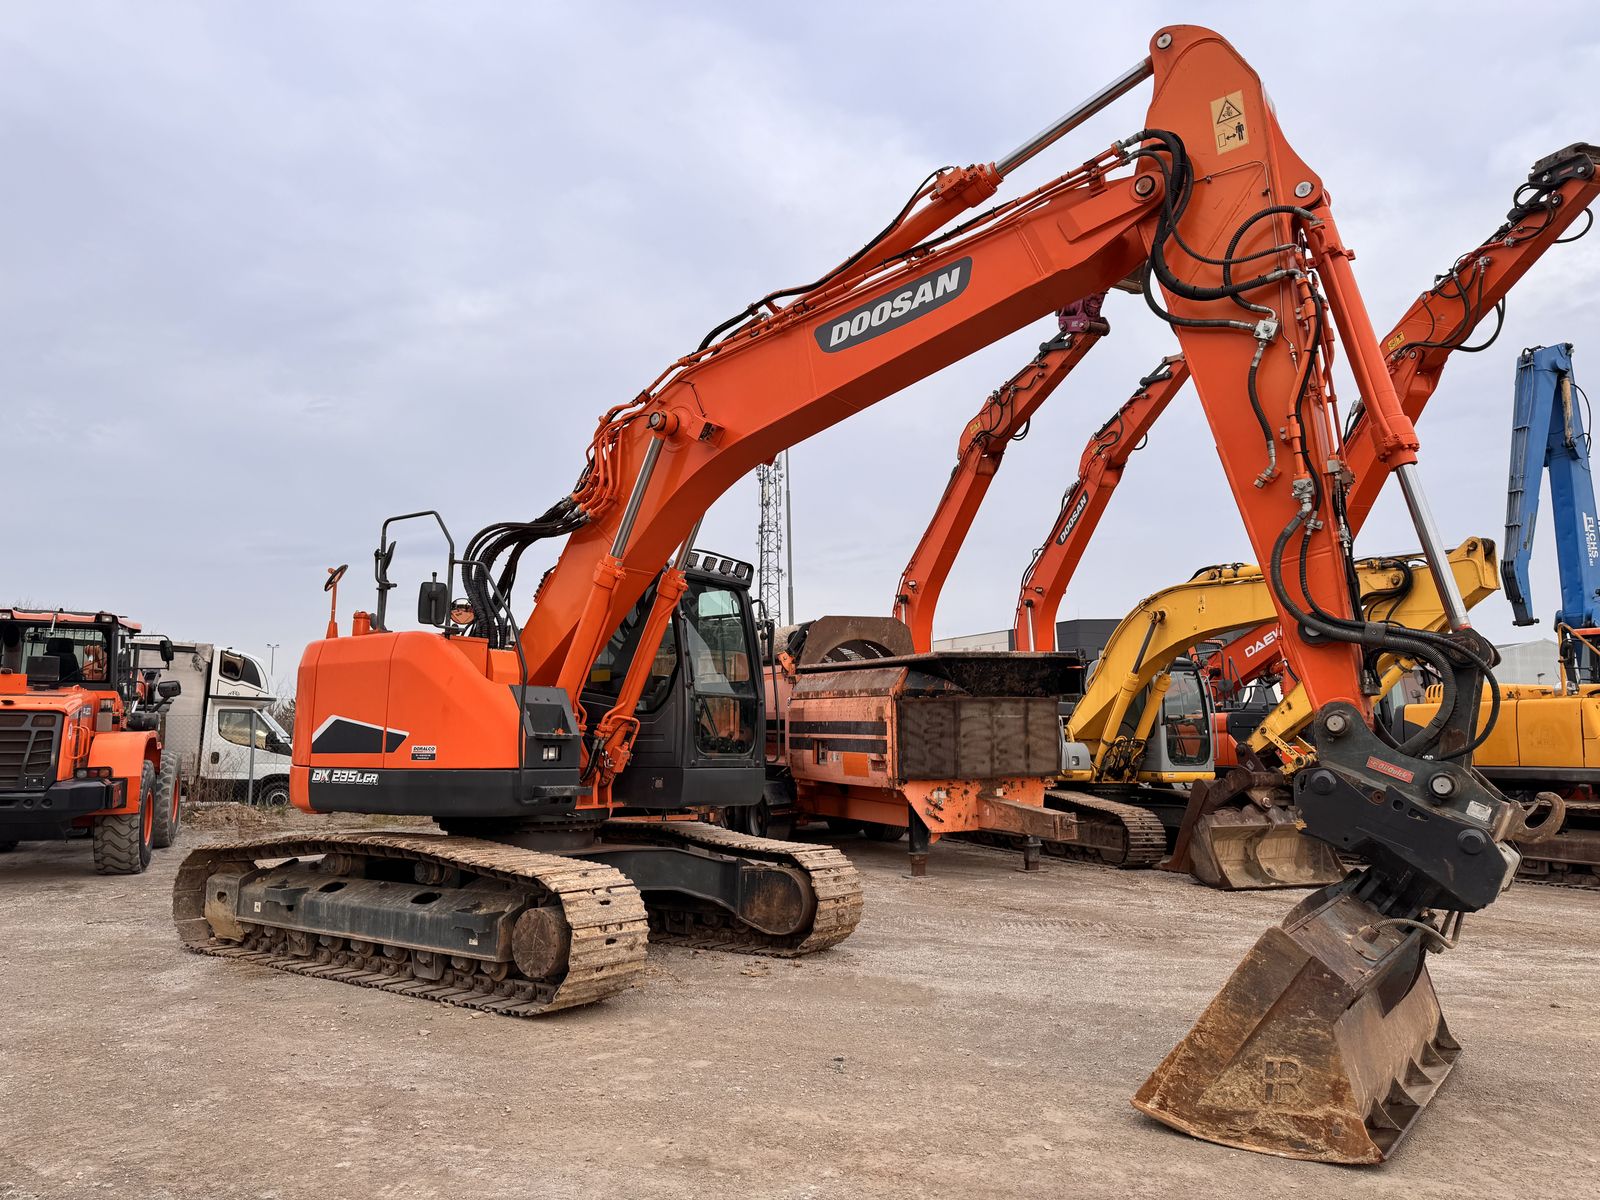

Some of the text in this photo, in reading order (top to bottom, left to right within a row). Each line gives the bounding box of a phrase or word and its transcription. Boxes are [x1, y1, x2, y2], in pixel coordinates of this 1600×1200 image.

[829, 266, 961, 348] DOOSAN
[1060, 494, 1087, 543] DOOSAN
[1586, 516, 1599, 559] FUCHS
